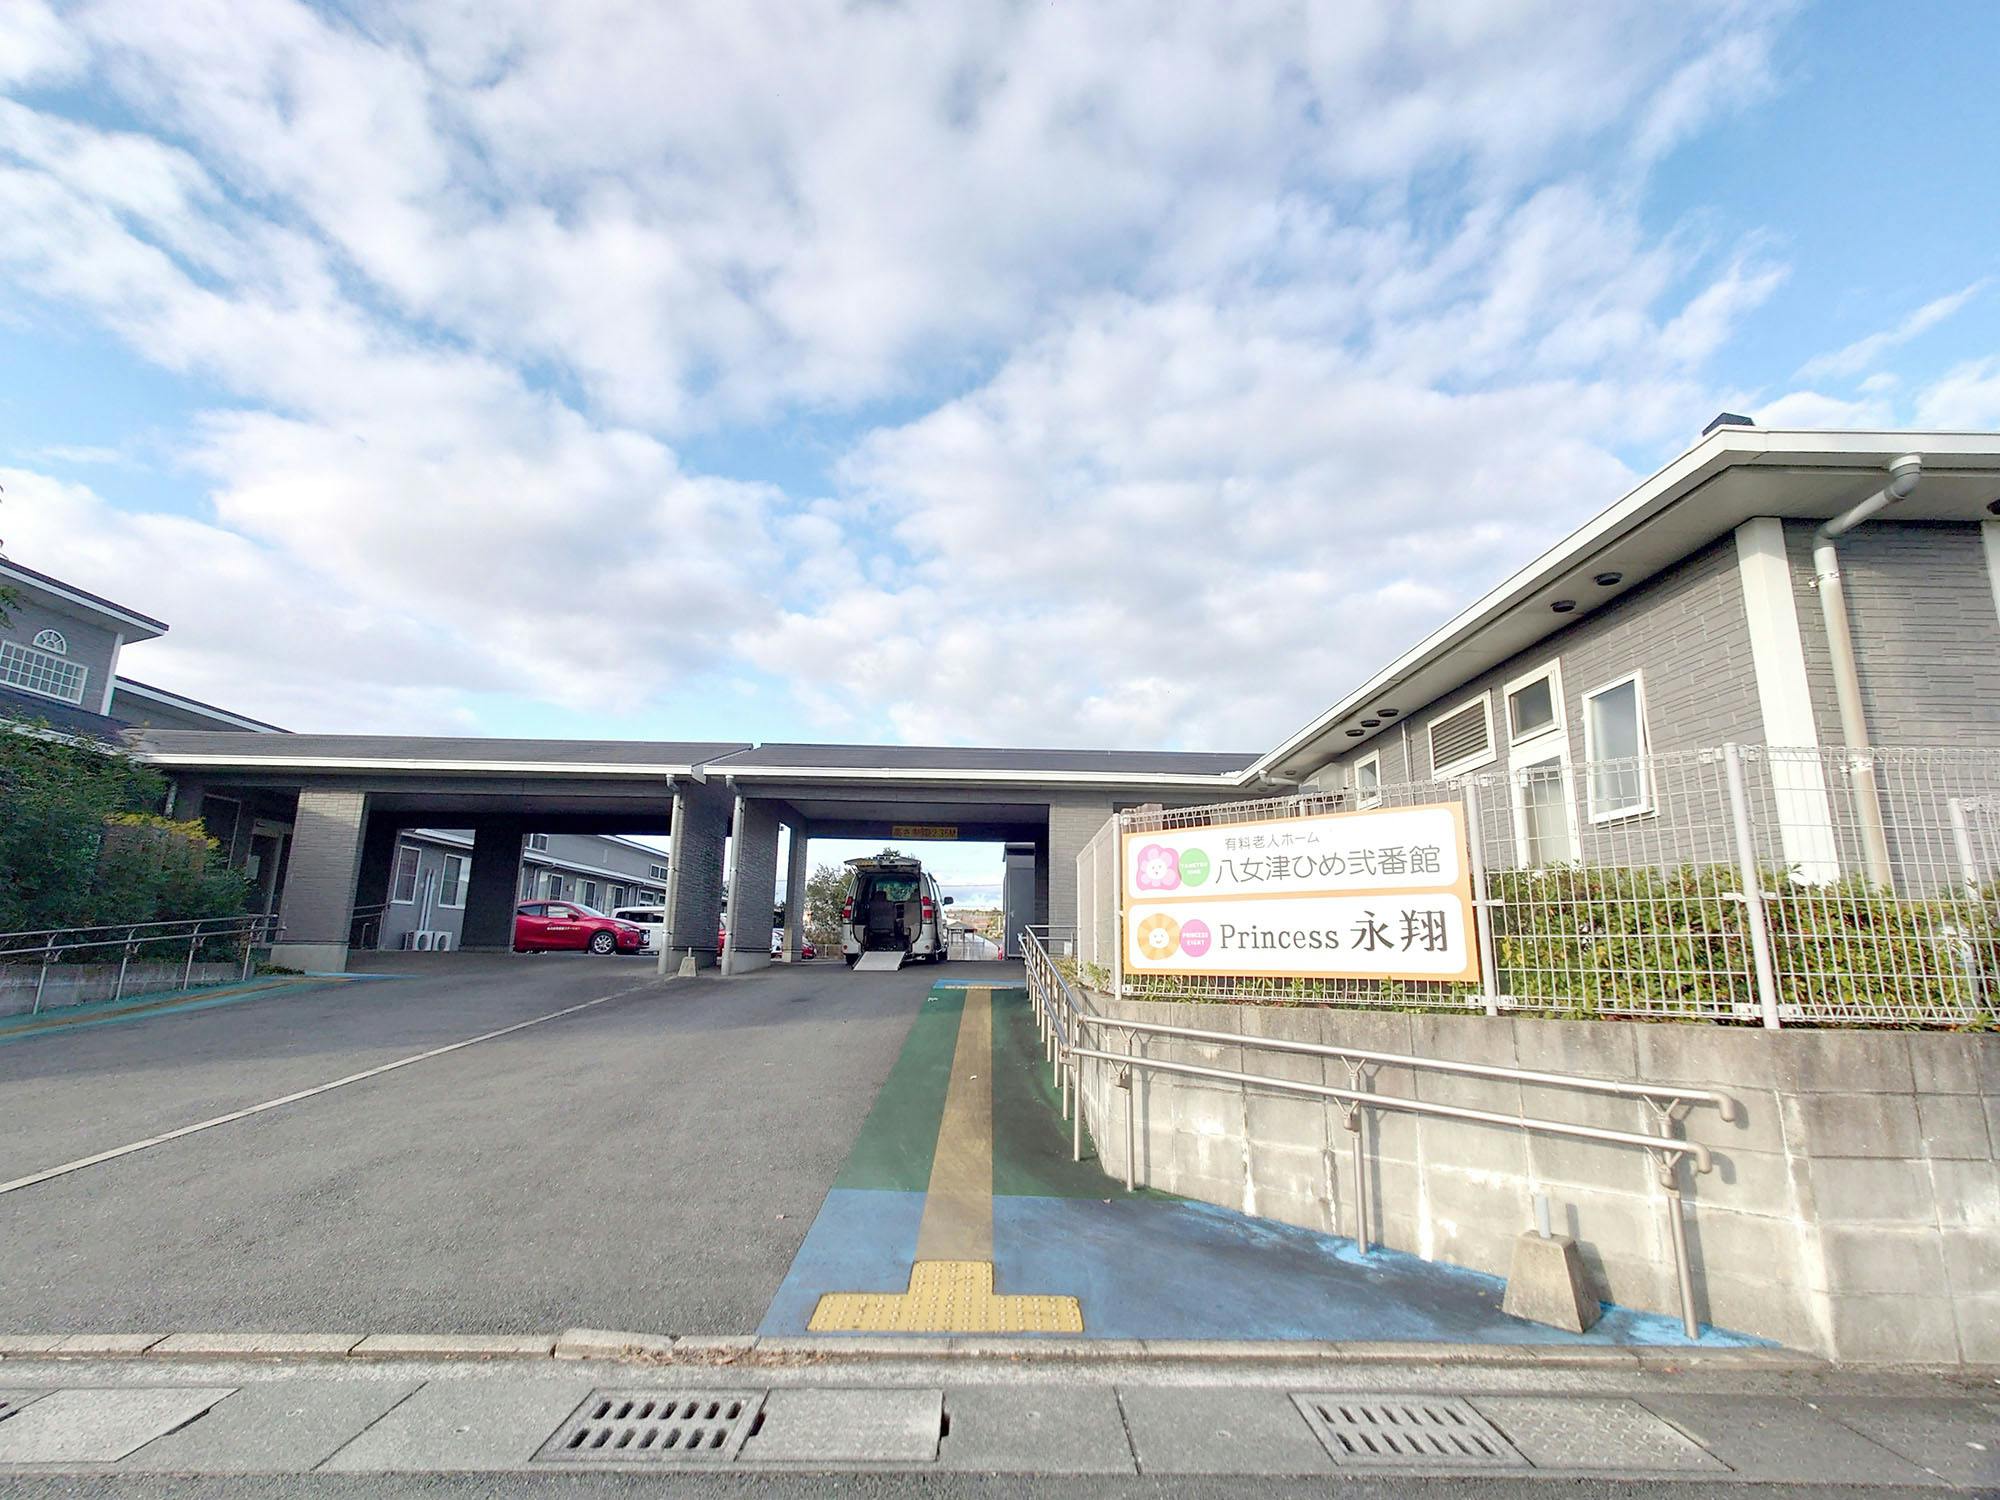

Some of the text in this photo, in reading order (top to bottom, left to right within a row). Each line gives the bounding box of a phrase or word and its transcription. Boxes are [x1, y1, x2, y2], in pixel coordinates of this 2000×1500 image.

[1224, 832, 1320, 850] 有料老人ホーム
[1215, 846, 1441, 884] 八女津ひめ弐番館
[1220, 909, 1448, 953] Princess 永翔
